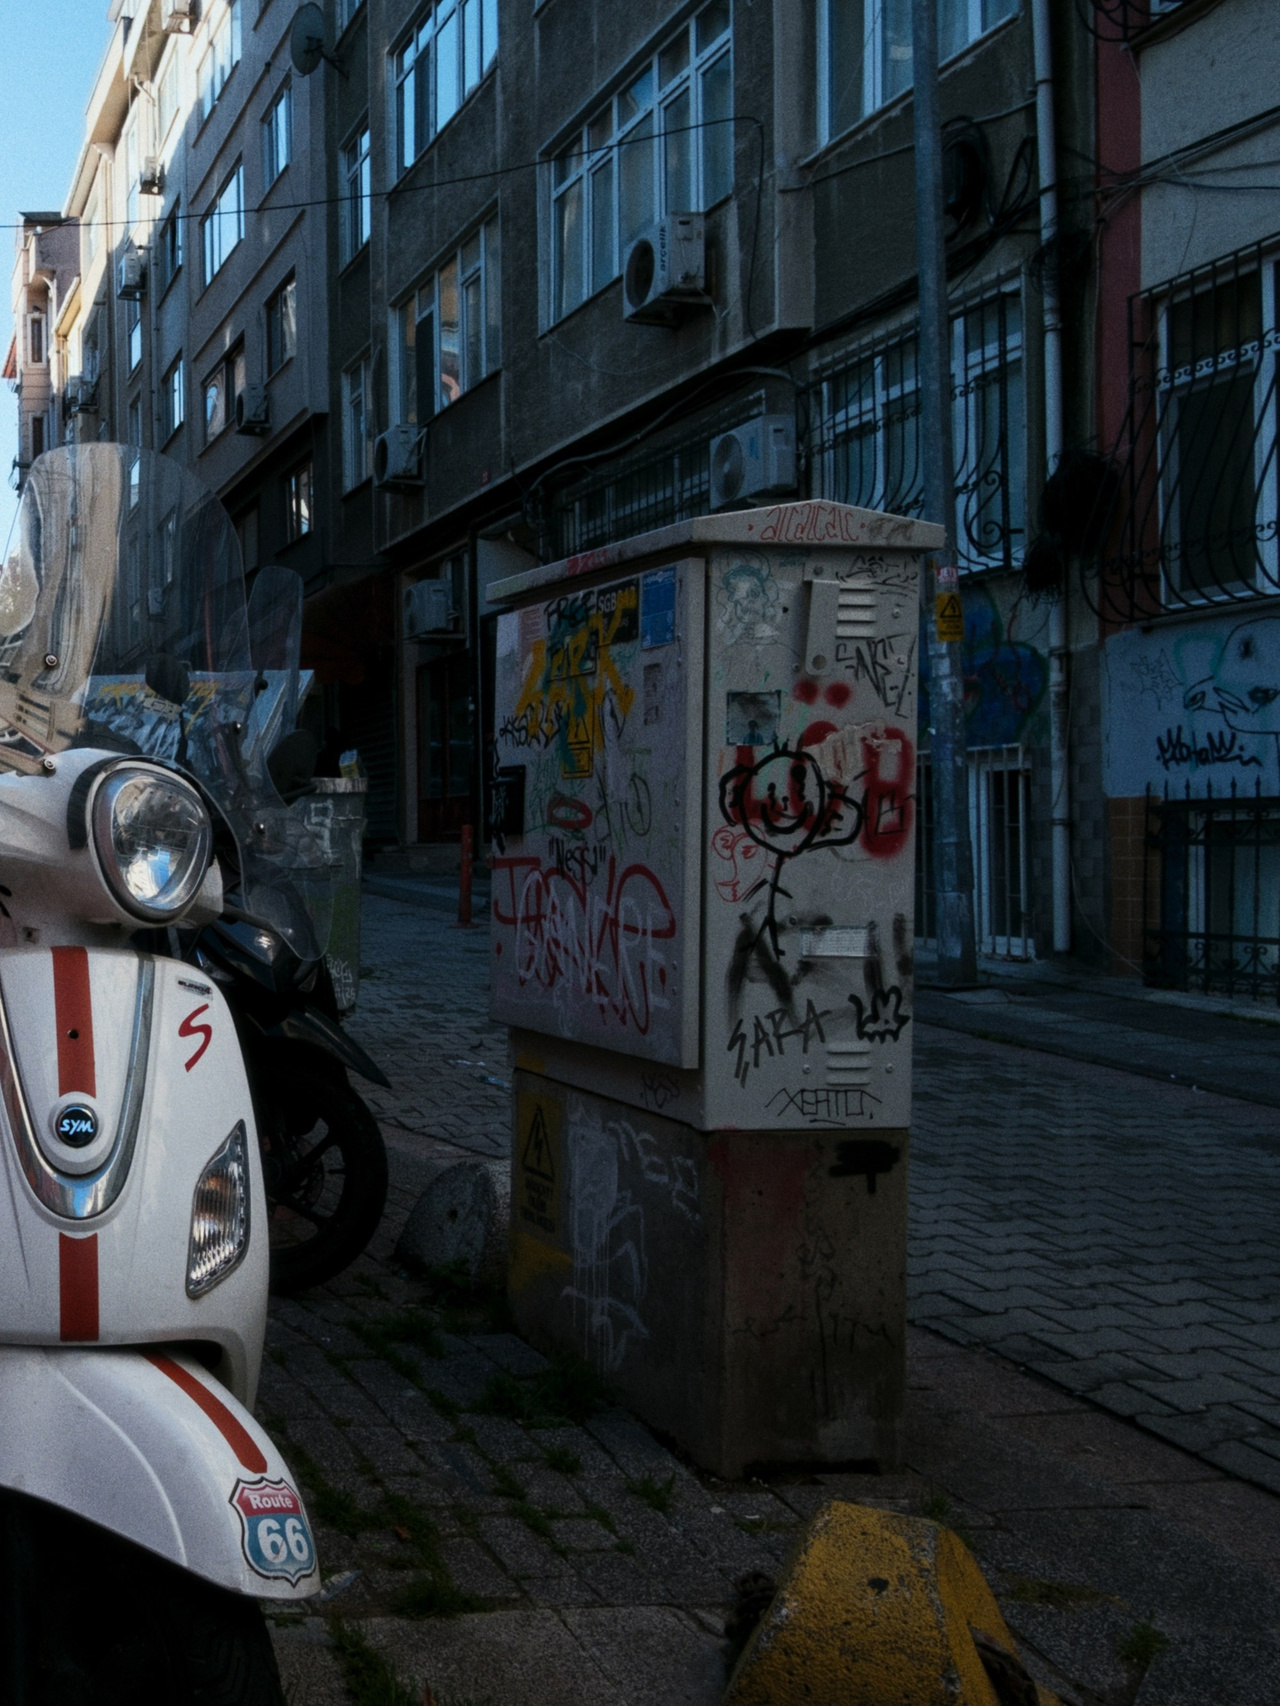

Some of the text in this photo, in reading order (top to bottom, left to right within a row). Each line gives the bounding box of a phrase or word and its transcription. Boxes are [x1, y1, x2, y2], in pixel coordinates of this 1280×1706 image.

[59, 1118, 94, 1136] SYM
[248, 1493, 294, 1510] Route
[256, 1517, 309, 1564] 66
